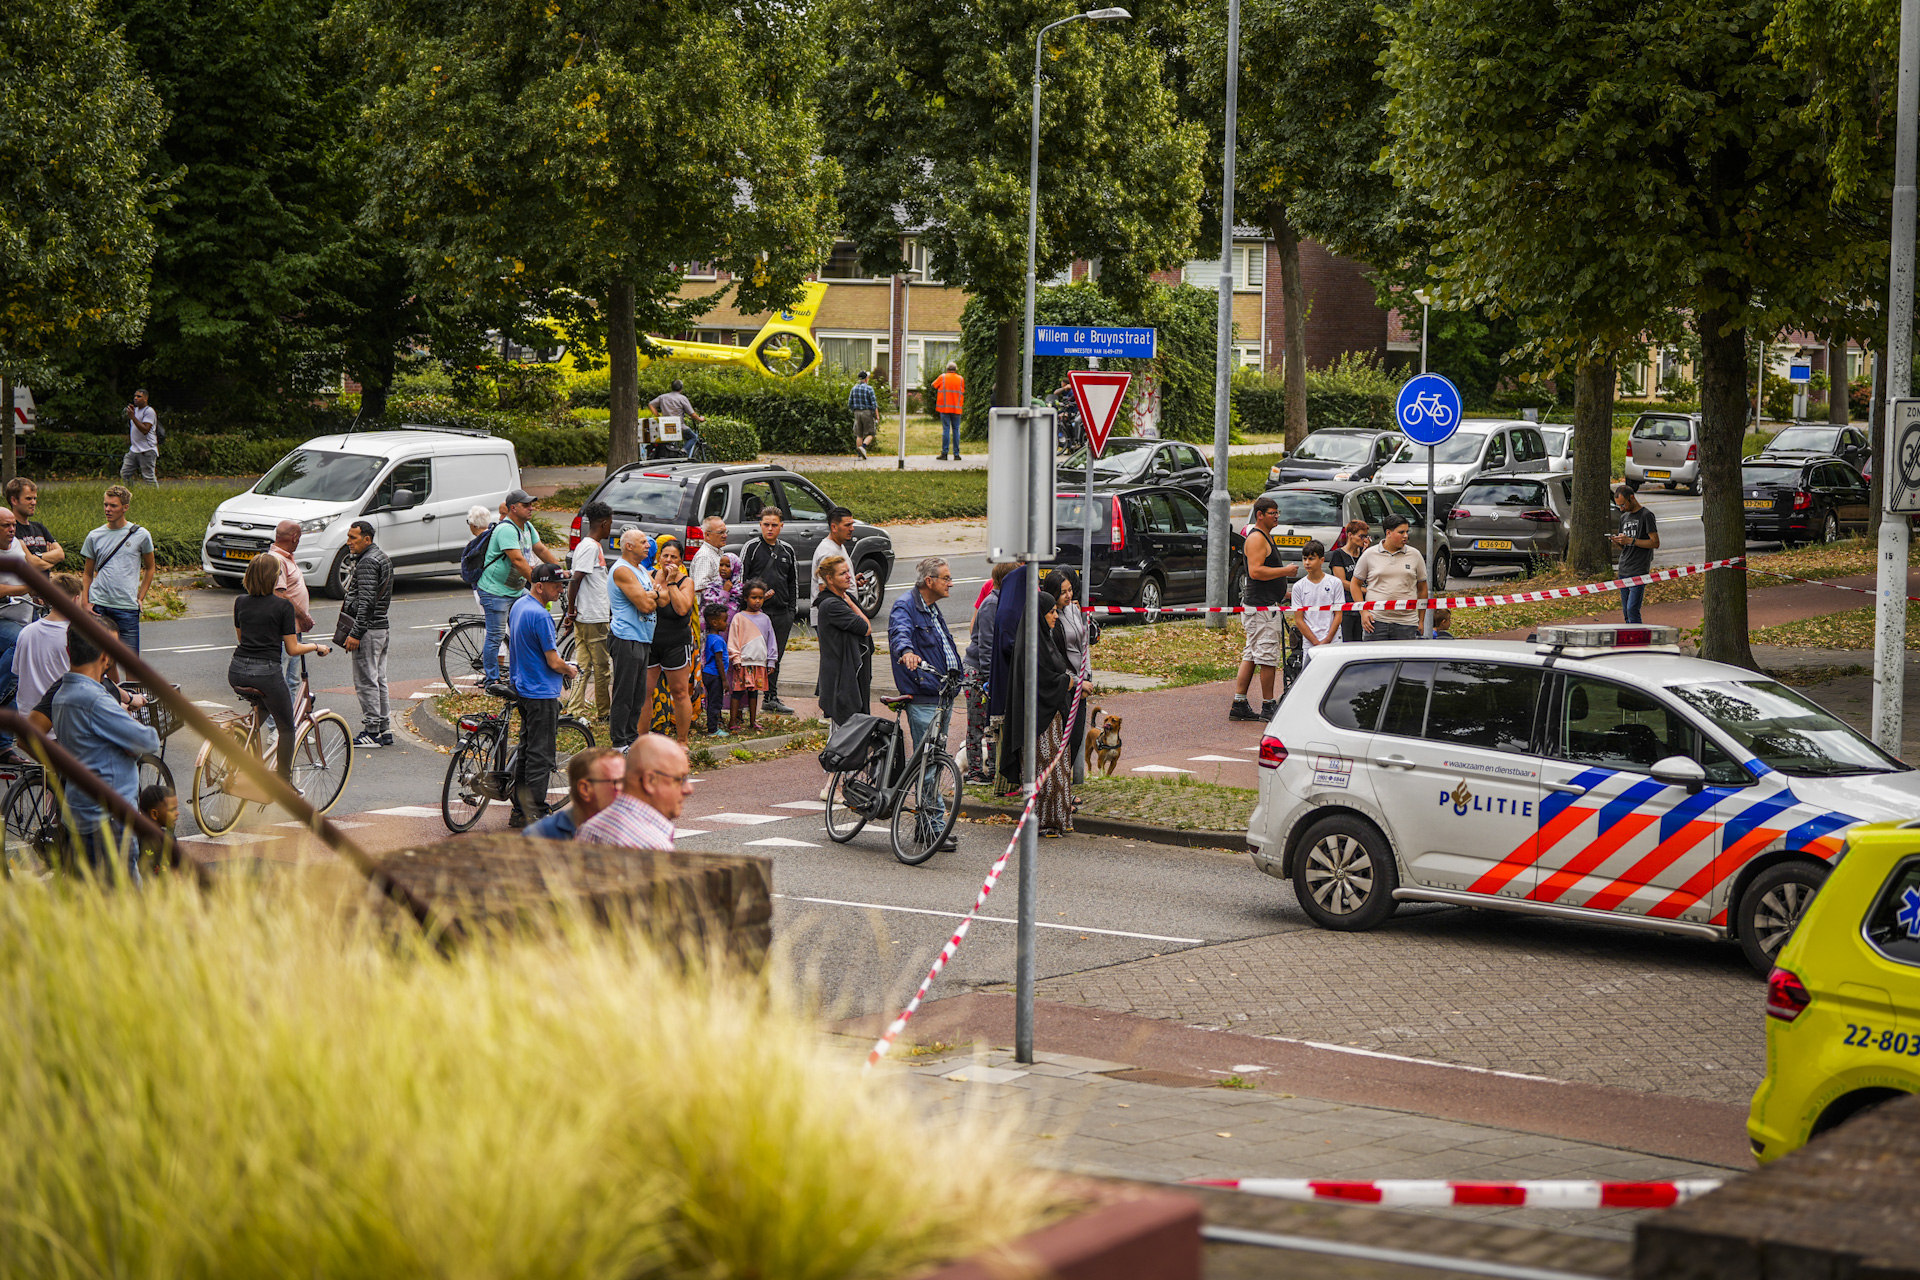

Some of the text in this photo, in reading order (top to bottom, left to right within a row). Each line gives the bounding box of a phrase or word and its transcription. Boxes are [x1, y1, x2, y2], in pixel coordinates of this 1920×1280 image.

[1037, 328, 1151, 347] Willem de Bruynstraat
[1885, 552, 1893, 560] 15
[1329, 760, 1340, 768] 112
[1439, 790, 1533, 817] POLITIE
[1843, 1024, 1920, 1057] 22-803
